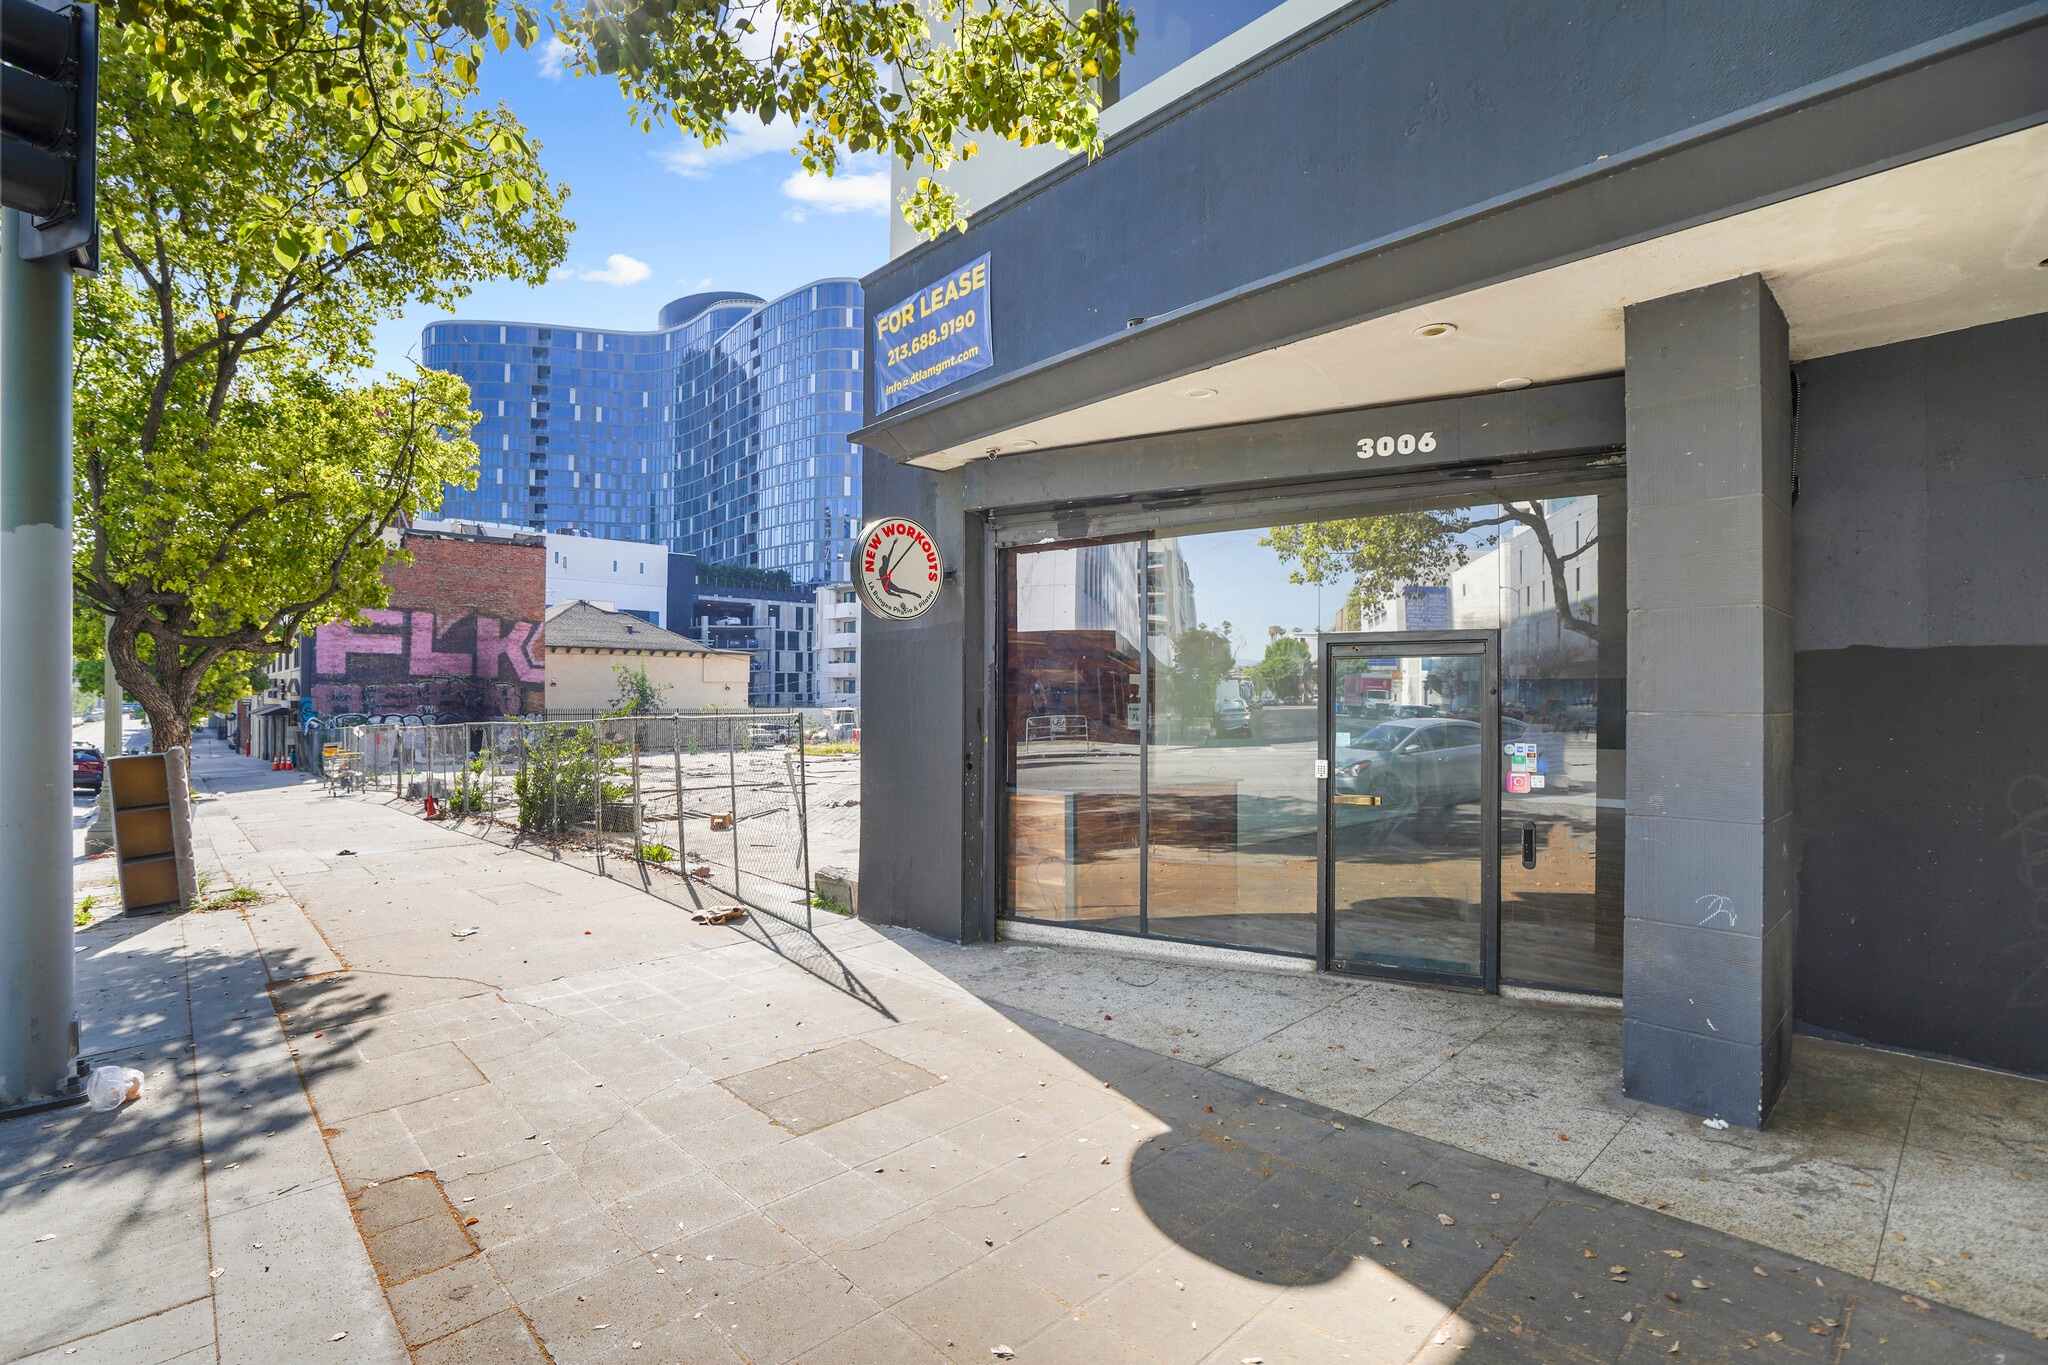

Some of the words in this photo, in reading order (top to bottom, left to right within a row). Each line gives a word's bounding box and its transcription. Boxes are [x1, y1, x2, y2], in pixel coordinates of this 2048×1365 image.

[878, 303, 915, 341] FOR
[920, 263, 986, 318] LEASE
[887, 309, 976, 367] 213.688.9190
[885, 346, 979, 395] info@dtlamgmt.com
[1356, 431, 1437, 459] 3006
[865, 533, 882, 572] NEW
[882, 523, 938, 582] WORKOUTS
[868, 581, 875, 591] LA
[872, 590, 892, 611] Bungee
[918, 590, 934, 608] Pilates
